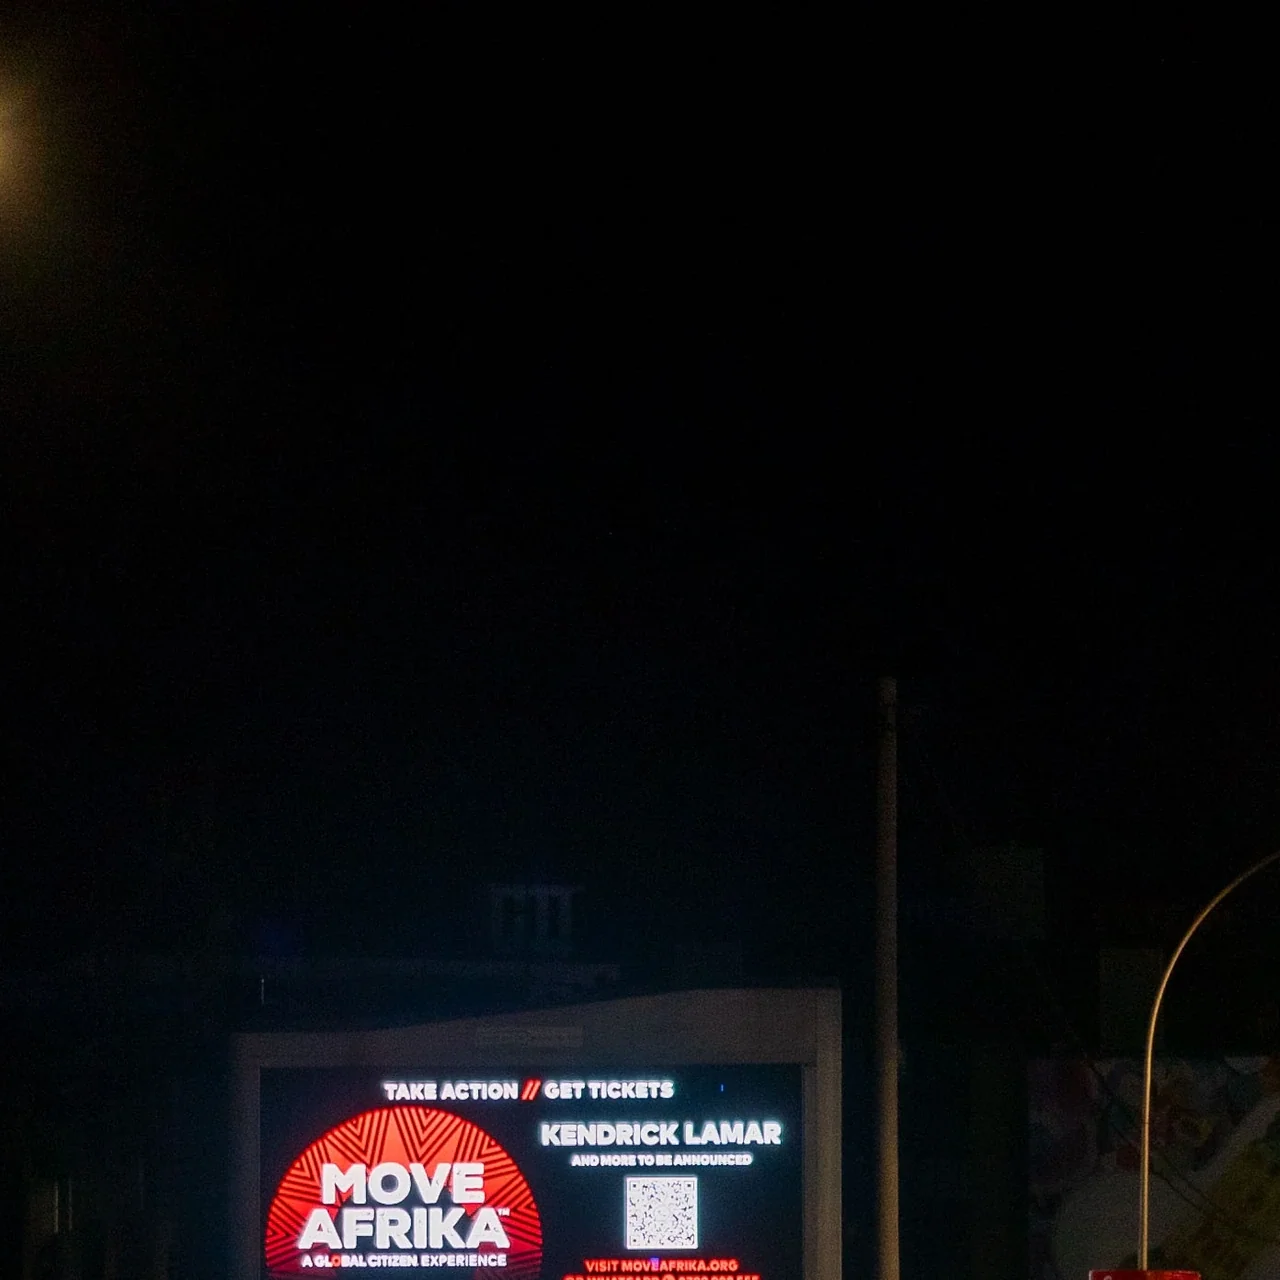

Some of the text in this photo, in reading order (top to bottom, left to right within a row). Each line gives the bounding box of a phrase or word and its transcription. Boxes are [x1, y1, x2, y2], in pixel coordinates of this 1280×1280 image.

[384, 1082, 438, 1100] TAKE
[441, 1082, 519, 1100] ACTION
[544, 1081, 586, 1099] GET
[588, 1081, 674, 1099] TICKETS
[541, 1121, 782, 1147] KENDRICK LAMAR
[571, 1153, 753, 1167] AND MORE TO BE ANNOUNCED
[322, 1162, 485, 1205] MOVE
[301, 1254, 508, 1267] A GLOBAL CITIZEN EXPERIENCE
[584, 1258, 739, 1272] VISIT MOVEAFRIKA.ORG
